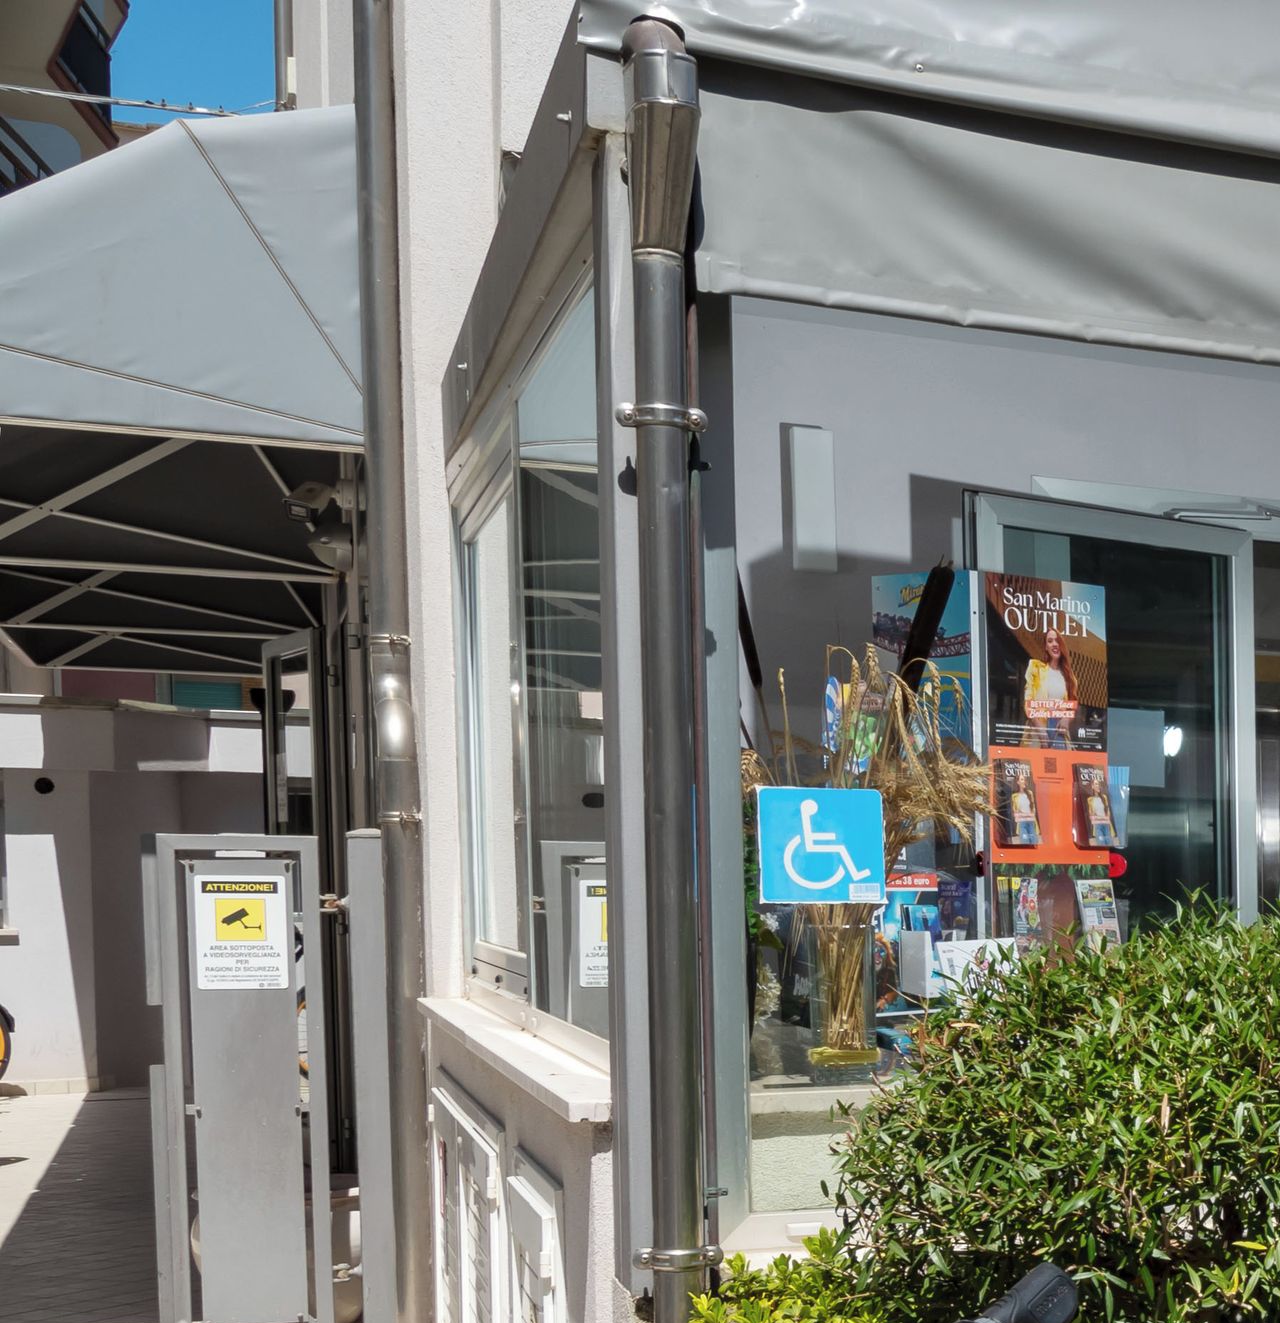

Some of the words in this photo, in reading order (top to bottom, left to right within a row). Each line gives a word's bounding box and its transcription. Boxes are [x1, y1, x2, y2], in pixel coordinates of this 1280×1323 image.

[1003, 587, 1033, 607] San
[1036, 591, 1091, 614] Marino
[1003, 607, 1092, 638] OUTLET
[1030, 700, 1054, 709] BETTER
[902, 876, 912, 885] 38
[205, 883, 274, 892] ATTENZIONE!
